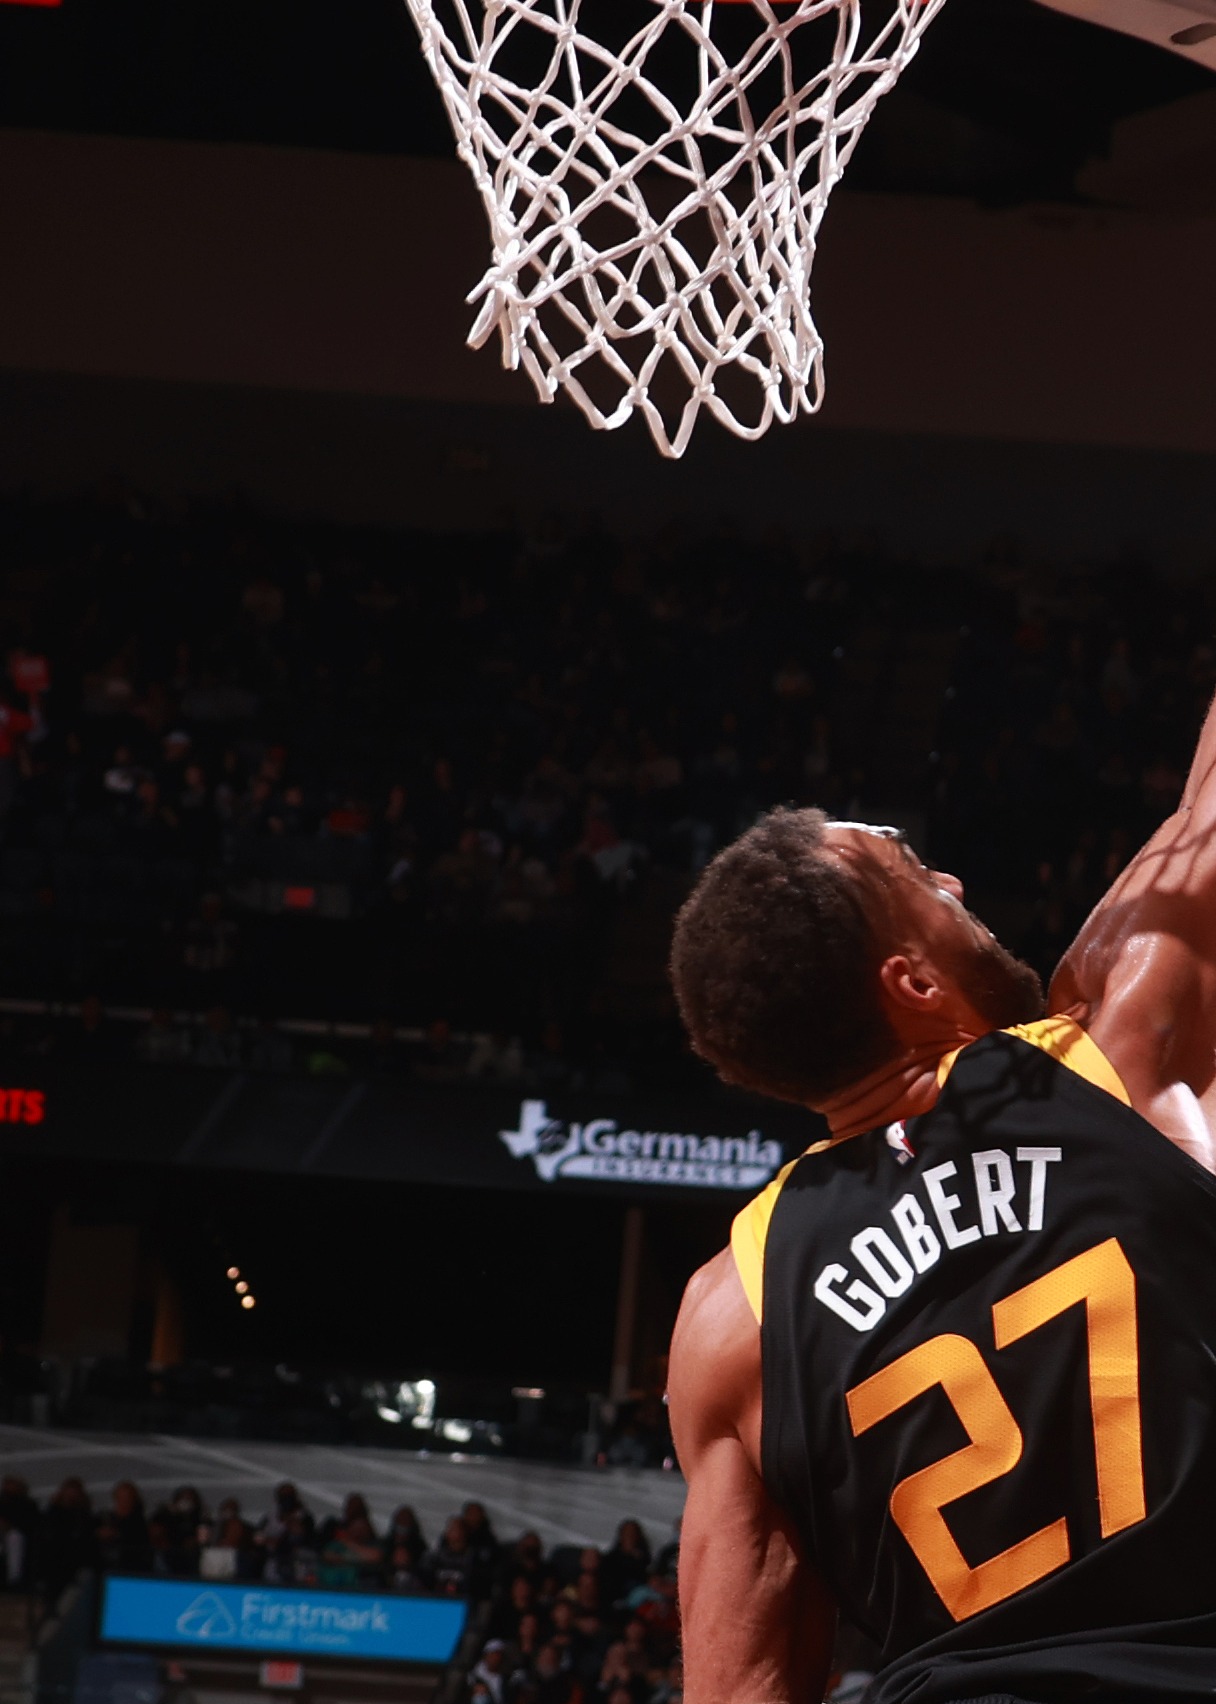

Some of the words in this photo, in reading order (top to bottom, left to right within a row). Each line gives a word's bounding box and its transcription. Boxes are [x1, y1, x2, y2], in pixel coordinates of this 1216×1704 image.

[583, 1119, 783, 1166] Germania
[814, 1147, 1062, 1332] GOBERT
[846, 1237, 1145, 1623] 27
[241, 1593, 389, 1632] Firstmark
